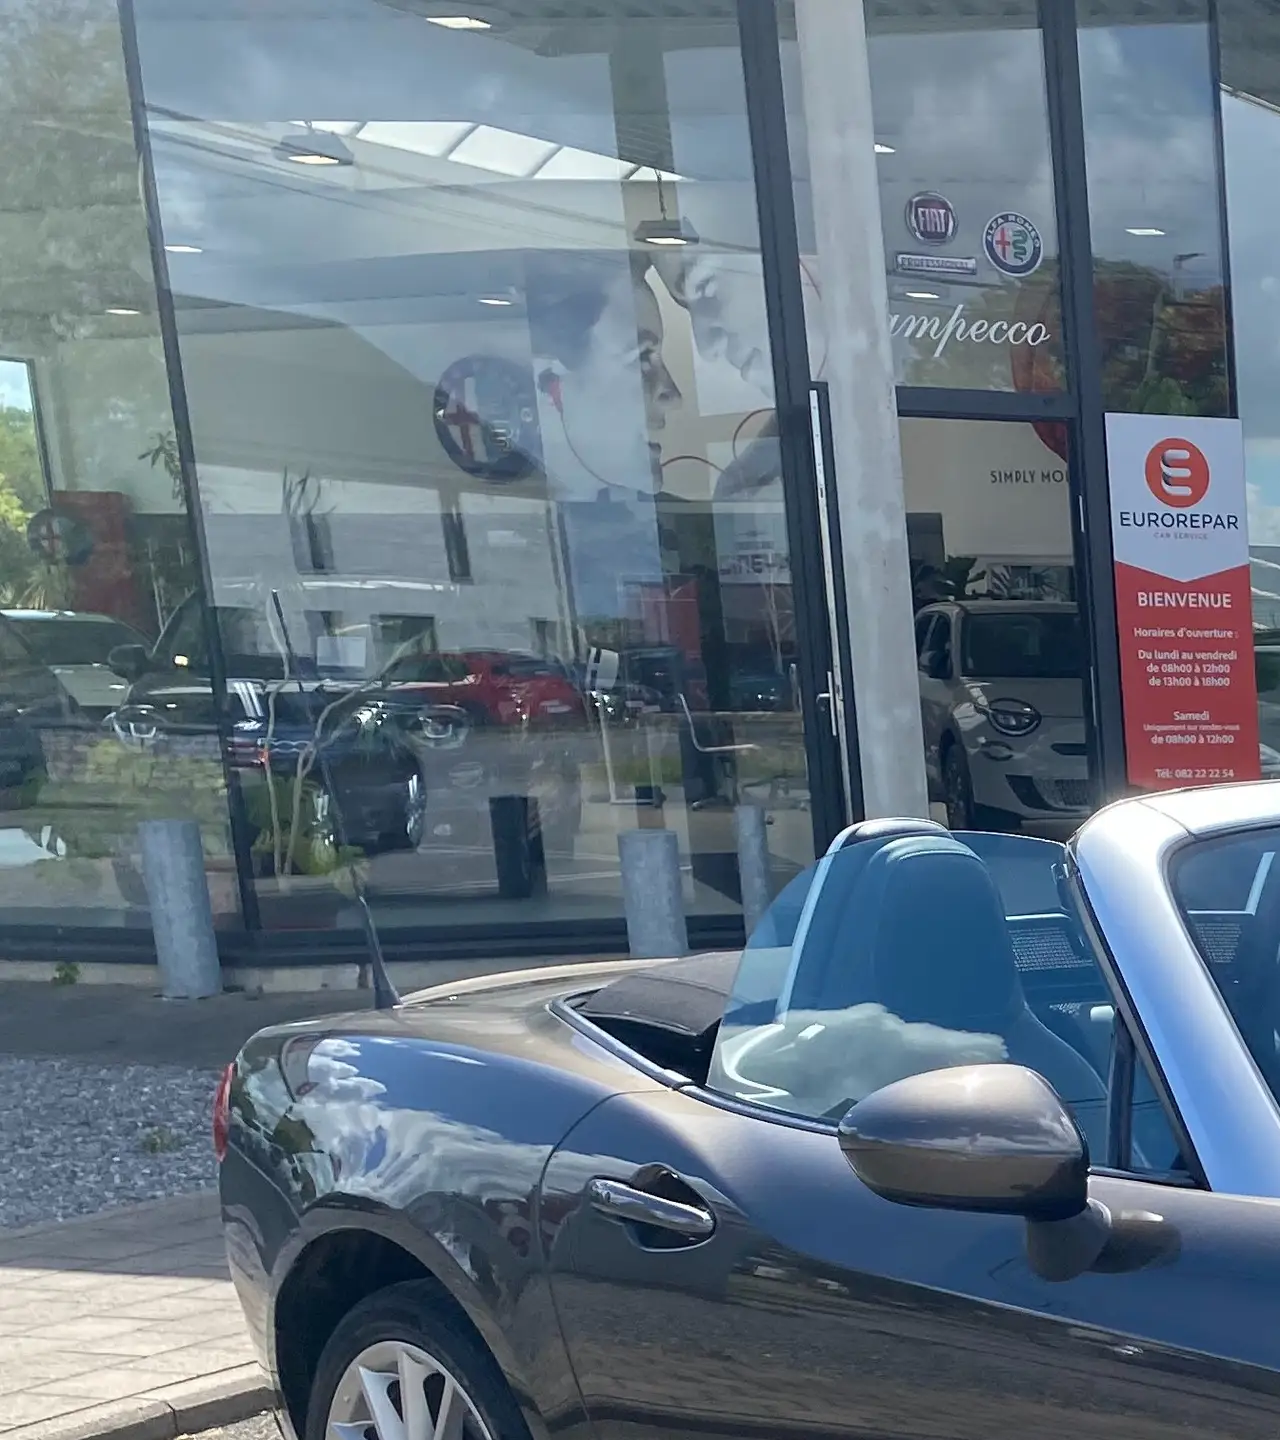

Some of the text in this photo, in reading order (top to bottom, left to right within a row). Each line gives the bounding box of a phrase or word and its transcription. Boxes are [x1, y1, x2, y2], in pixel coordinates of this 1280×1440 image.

[917, 207, 947, 233] FIAT
[986, 215, 1041, 248] ALFA ROMEO
[990, 470, 1035, 484] SIMPLY
[1120, 512, 1239, 530] EUROREPAR
[1154, 532, 1208, 540] CAR SERVICE
[1137, 592, 1232, 608] BIENVENUE
[1134, 627, 1175, 637] Horaires
[1138, 650, 1237, 660] Du lundi au vendredi
[1147, 663, 1159, 673] de
[1202, 664, 1230, 673] 12h00
[1149, 676, 1161, 686] de
[1163, 676, 1191, 686] 13h00
[1173, 711, 1210, 720] Samedi
[1151, 734, 1164, 744] de
[1206, 734, 1234, 744] 12h00
[1195, 769, 1207, 778] 22
[1209, 769, 1221, 778] 22
